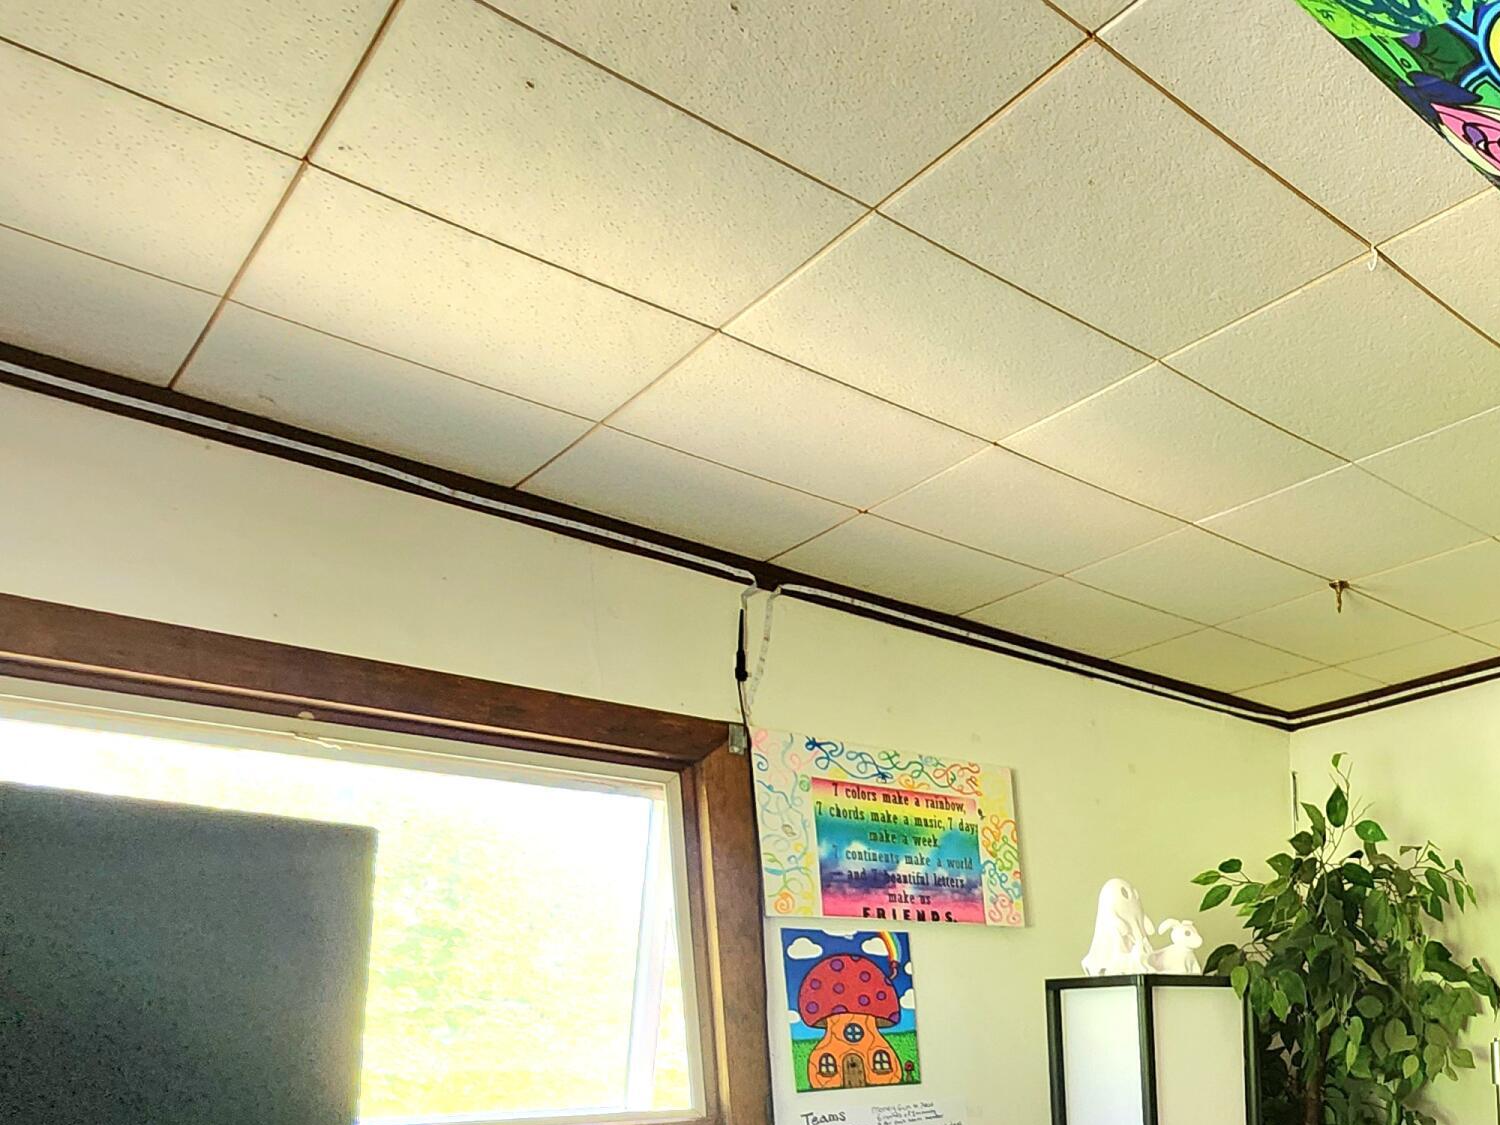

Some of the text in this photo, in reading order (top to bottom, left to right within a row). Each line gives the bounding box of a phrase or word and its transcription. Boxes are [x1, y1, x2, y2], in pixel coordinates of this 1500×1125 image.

[831, 782, 966, 814] 7 colors make a rainbow,
[815, 801, 822, 816] 7
[829, 804, 865, 821] chords
[870, 810, 898, 825] make
[903, 816, 909, 826] a
[914, 815, 945, 831] music,
[869, 829, 898, 844] make
[902, 835, 909, 845] a
[845, 849, 900, 864] continents
[904, 852, 931, 866] make
[936, 857, 942, 867] a
[946, 857, 973, 870] world
[847, 868, 866, 881] and
[883, 870, 929, 887] beautiful
[933, 873, 965, 888] letters
[888, 890, 931, 905] make us
